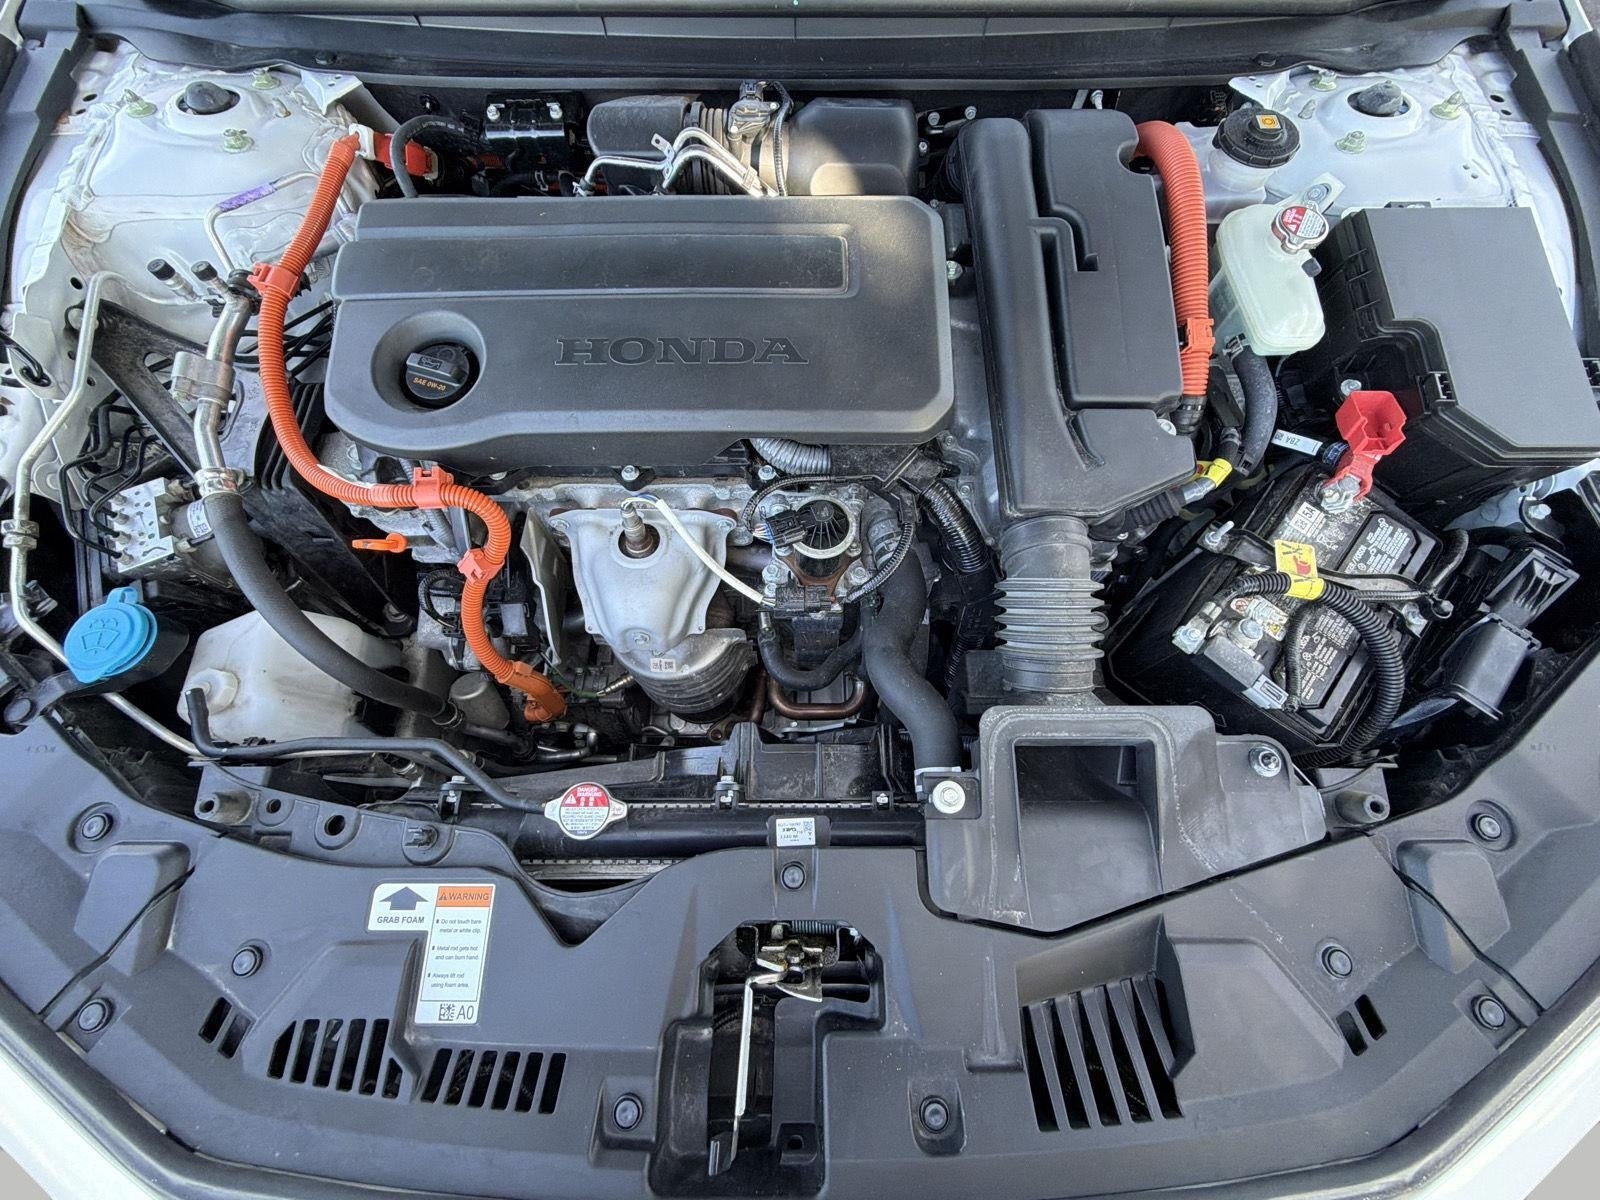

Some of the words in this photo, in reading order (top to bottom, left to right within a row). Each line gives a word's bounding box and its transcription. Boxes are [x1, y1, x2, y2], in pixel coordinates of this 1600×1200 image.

[555, 336, 809, 366] HONDA
[413, 377, 427, 386] SAE
[427, 381, 447, 391] 0W-20
[449, 892, 489, 901] WARNING
[377, 916, 400, 924] GRAB
[401, 916, 425, 924] FOAM
[456, 1005, 475, 1021] A0
